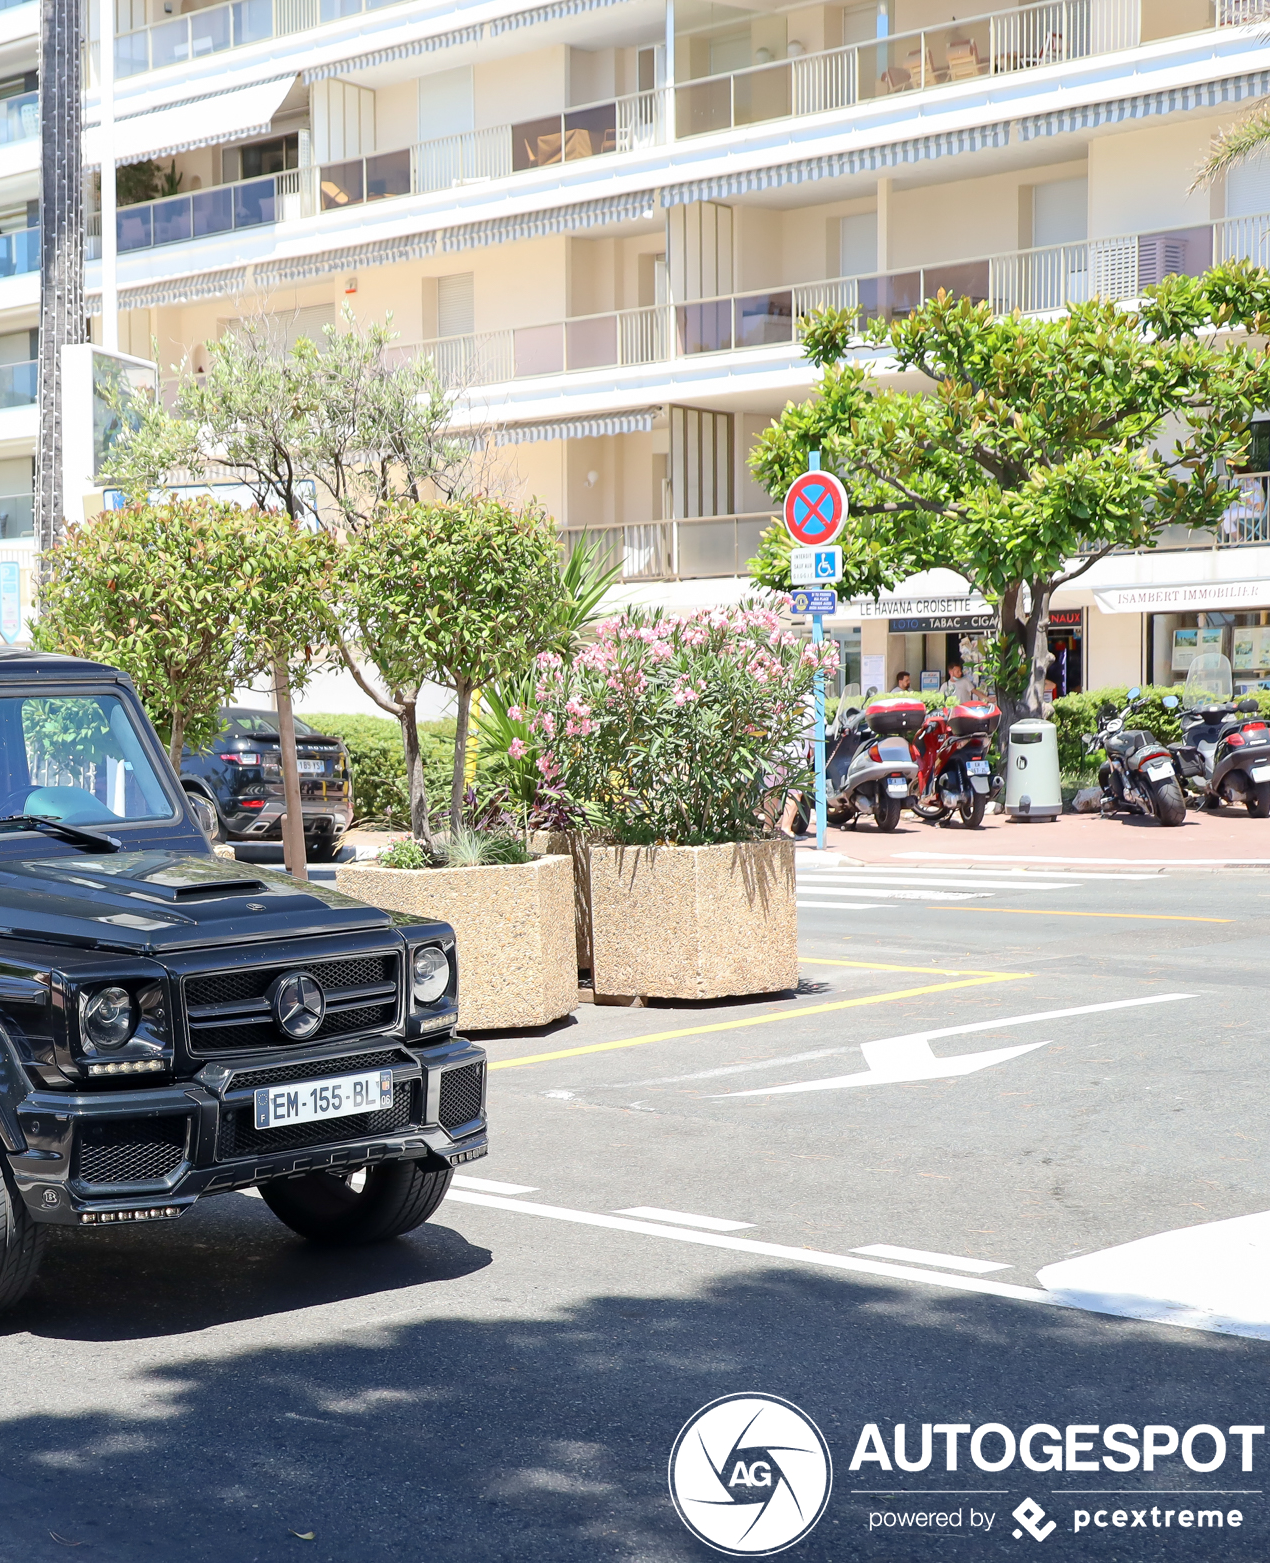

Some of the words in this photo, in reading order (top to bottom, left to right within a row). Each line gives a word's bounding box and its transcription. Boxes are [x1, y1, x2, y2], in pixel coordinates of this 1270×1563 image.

[1118, 591, 1180, 604] ISAMBERT
[1183, 586, 1259, 601] IMMOBILIER
[860, 602, 872, 616] LE
[875, 600, 913, 615] HAVANA
[916, 598, 971, 614] CROISETTE
[893, 619, 919, 629] LOTO
[929, 617, 961, 628] TABAC
[971, 615, 998, 627] CIGA
[1049, 612, 1081, 624] NAUX
[381, 1094, 390, 1105] 06
[260, 1113, 266, 1123] F
